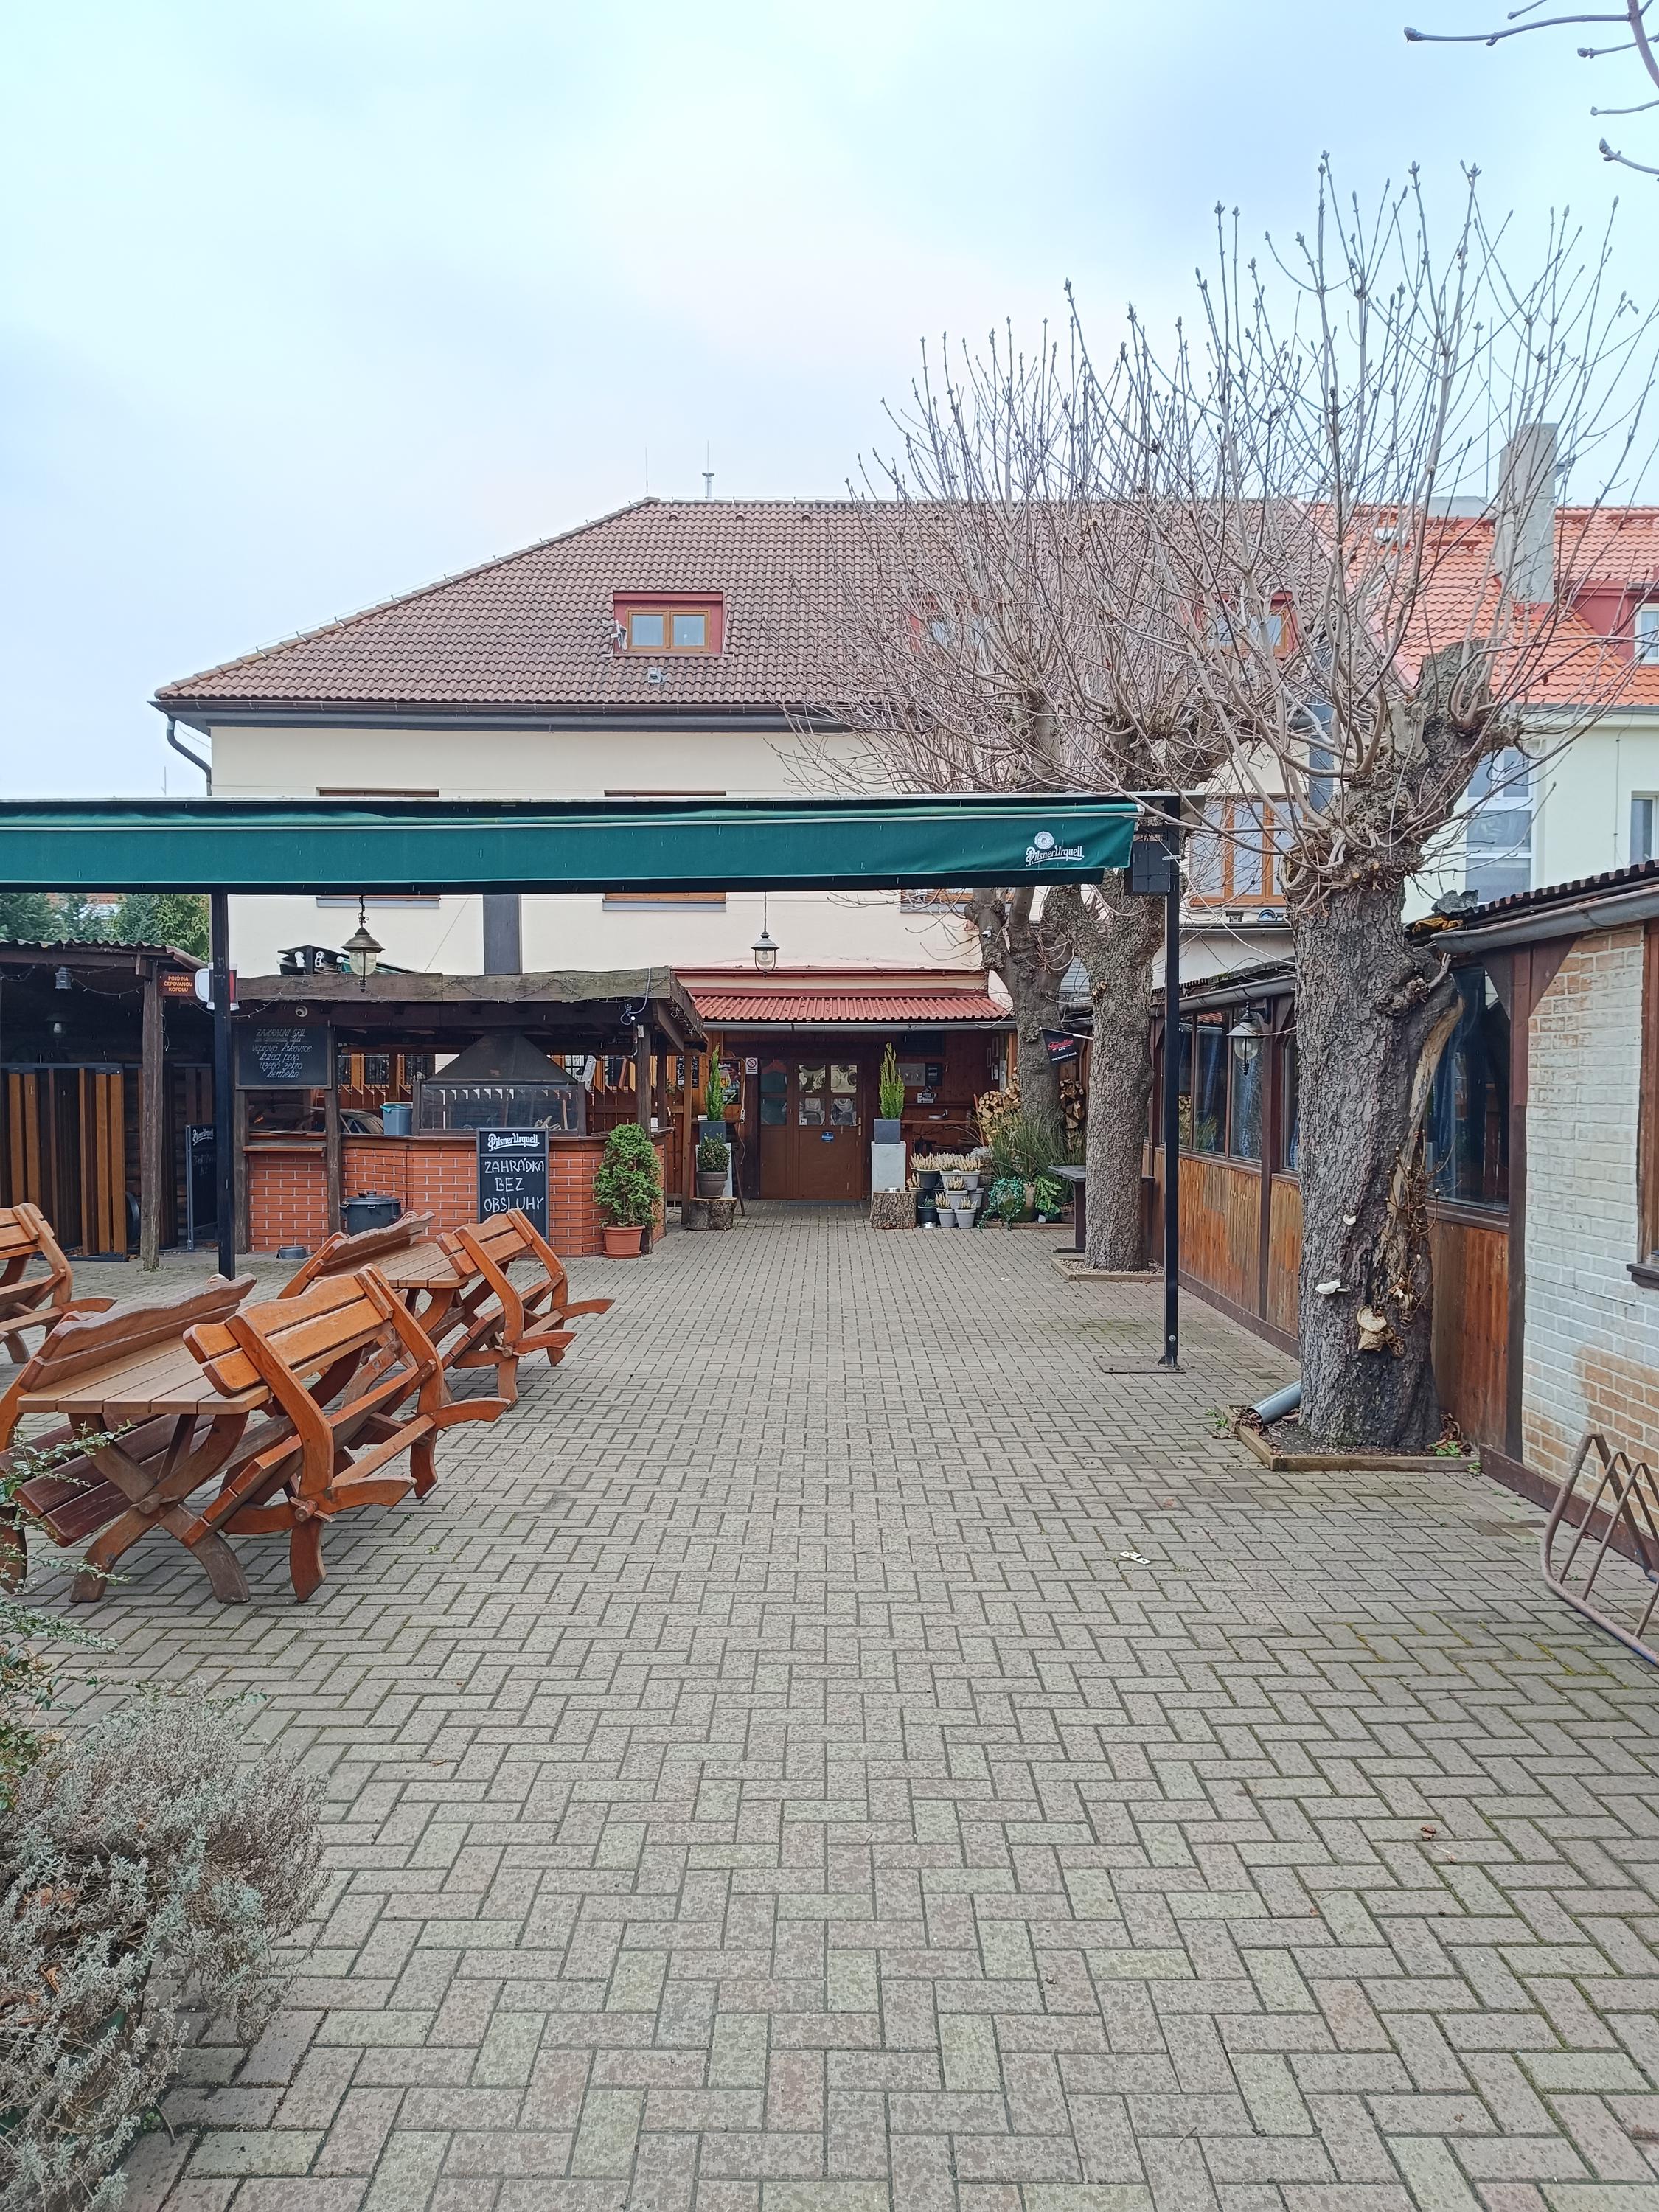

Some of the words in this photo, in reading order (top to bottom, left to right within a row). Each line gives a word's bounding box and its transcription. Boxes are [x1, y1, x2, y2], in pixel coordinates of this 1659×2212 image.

[1026, 846, 1055, 866] Pilsner
[1054, 845, 1083, 861] Urquell
[487, 1133, 513, 1152] Pilsner
[512, 1133, 538, 1147] Urquell
[484, 1158, 544, 1173] ZAHRÁDKA
[495, 1177, 525, 1192] BEZ
